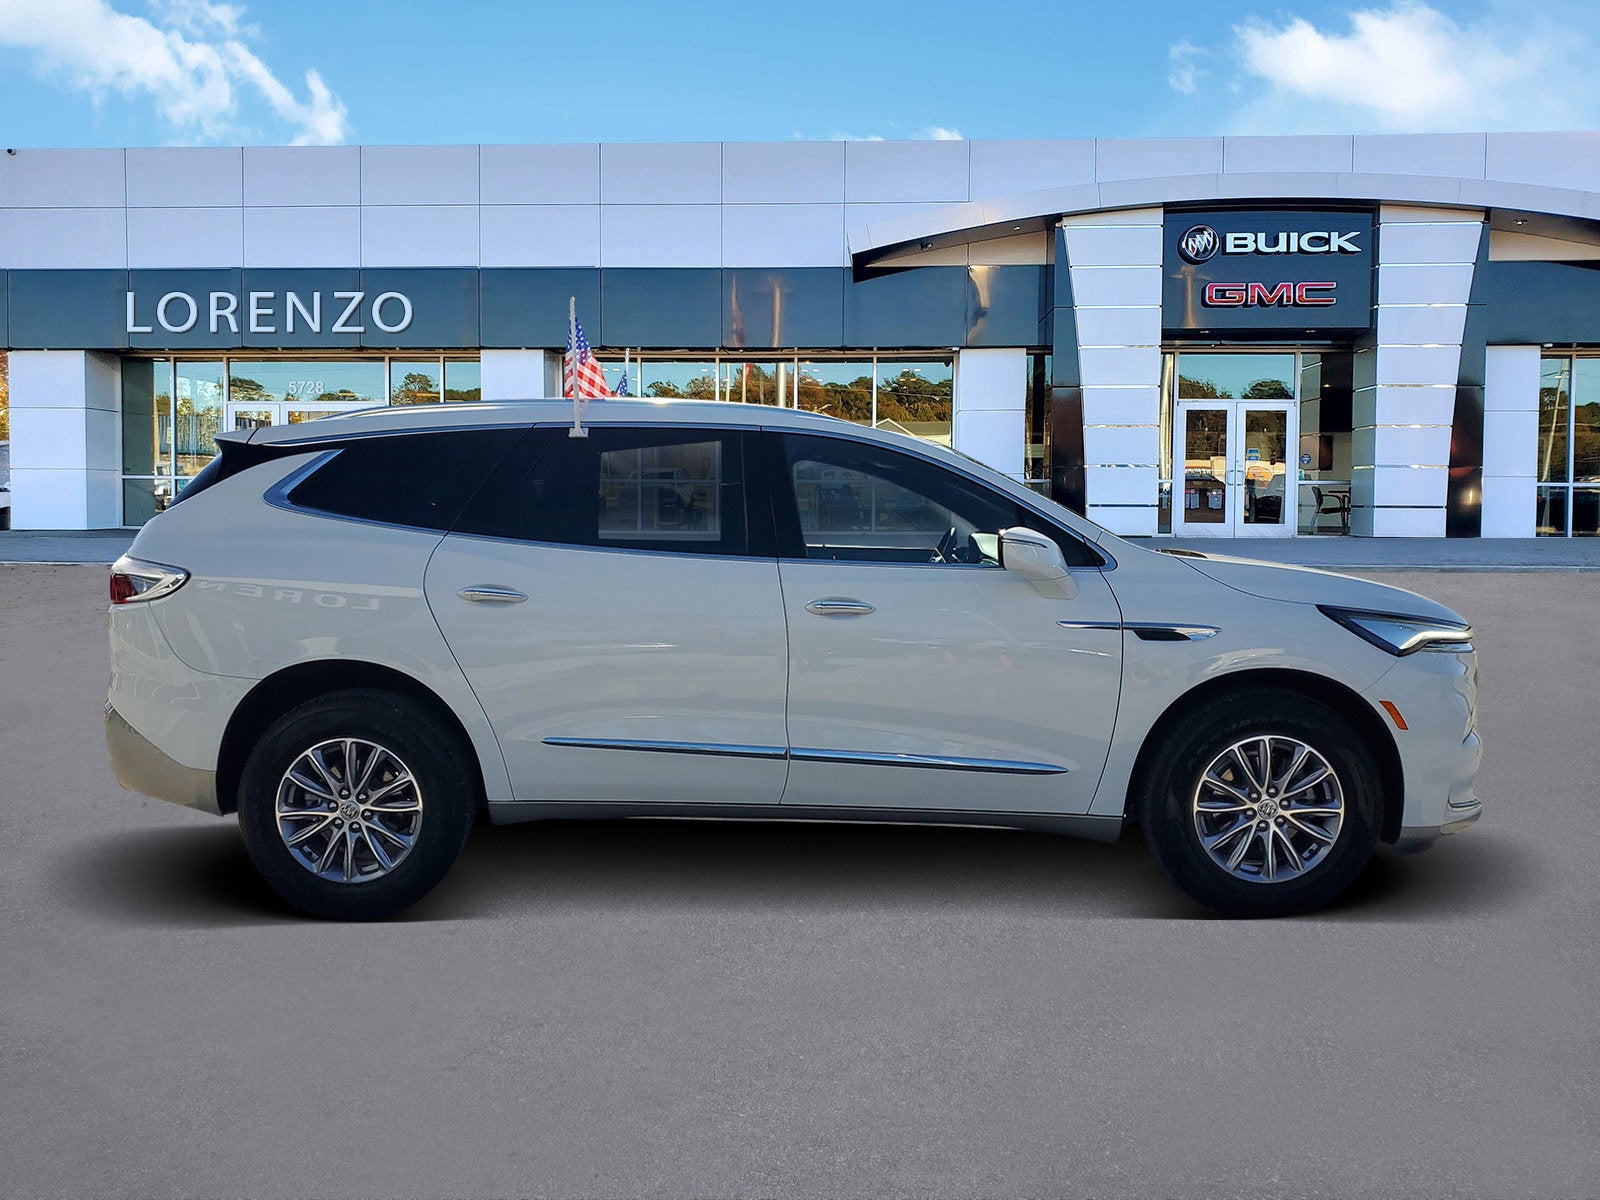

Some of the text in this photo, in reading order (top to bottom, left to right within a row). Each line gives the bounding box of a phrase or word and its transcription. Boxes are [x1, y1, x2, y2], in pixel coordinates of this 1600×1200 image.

[1225, 231, 1362, 253] BUICK
[1205, 281, 1337, 304] GMC
[126, 291, 413, 333] LORENZO
[288, 380, 325, 395] 5728
